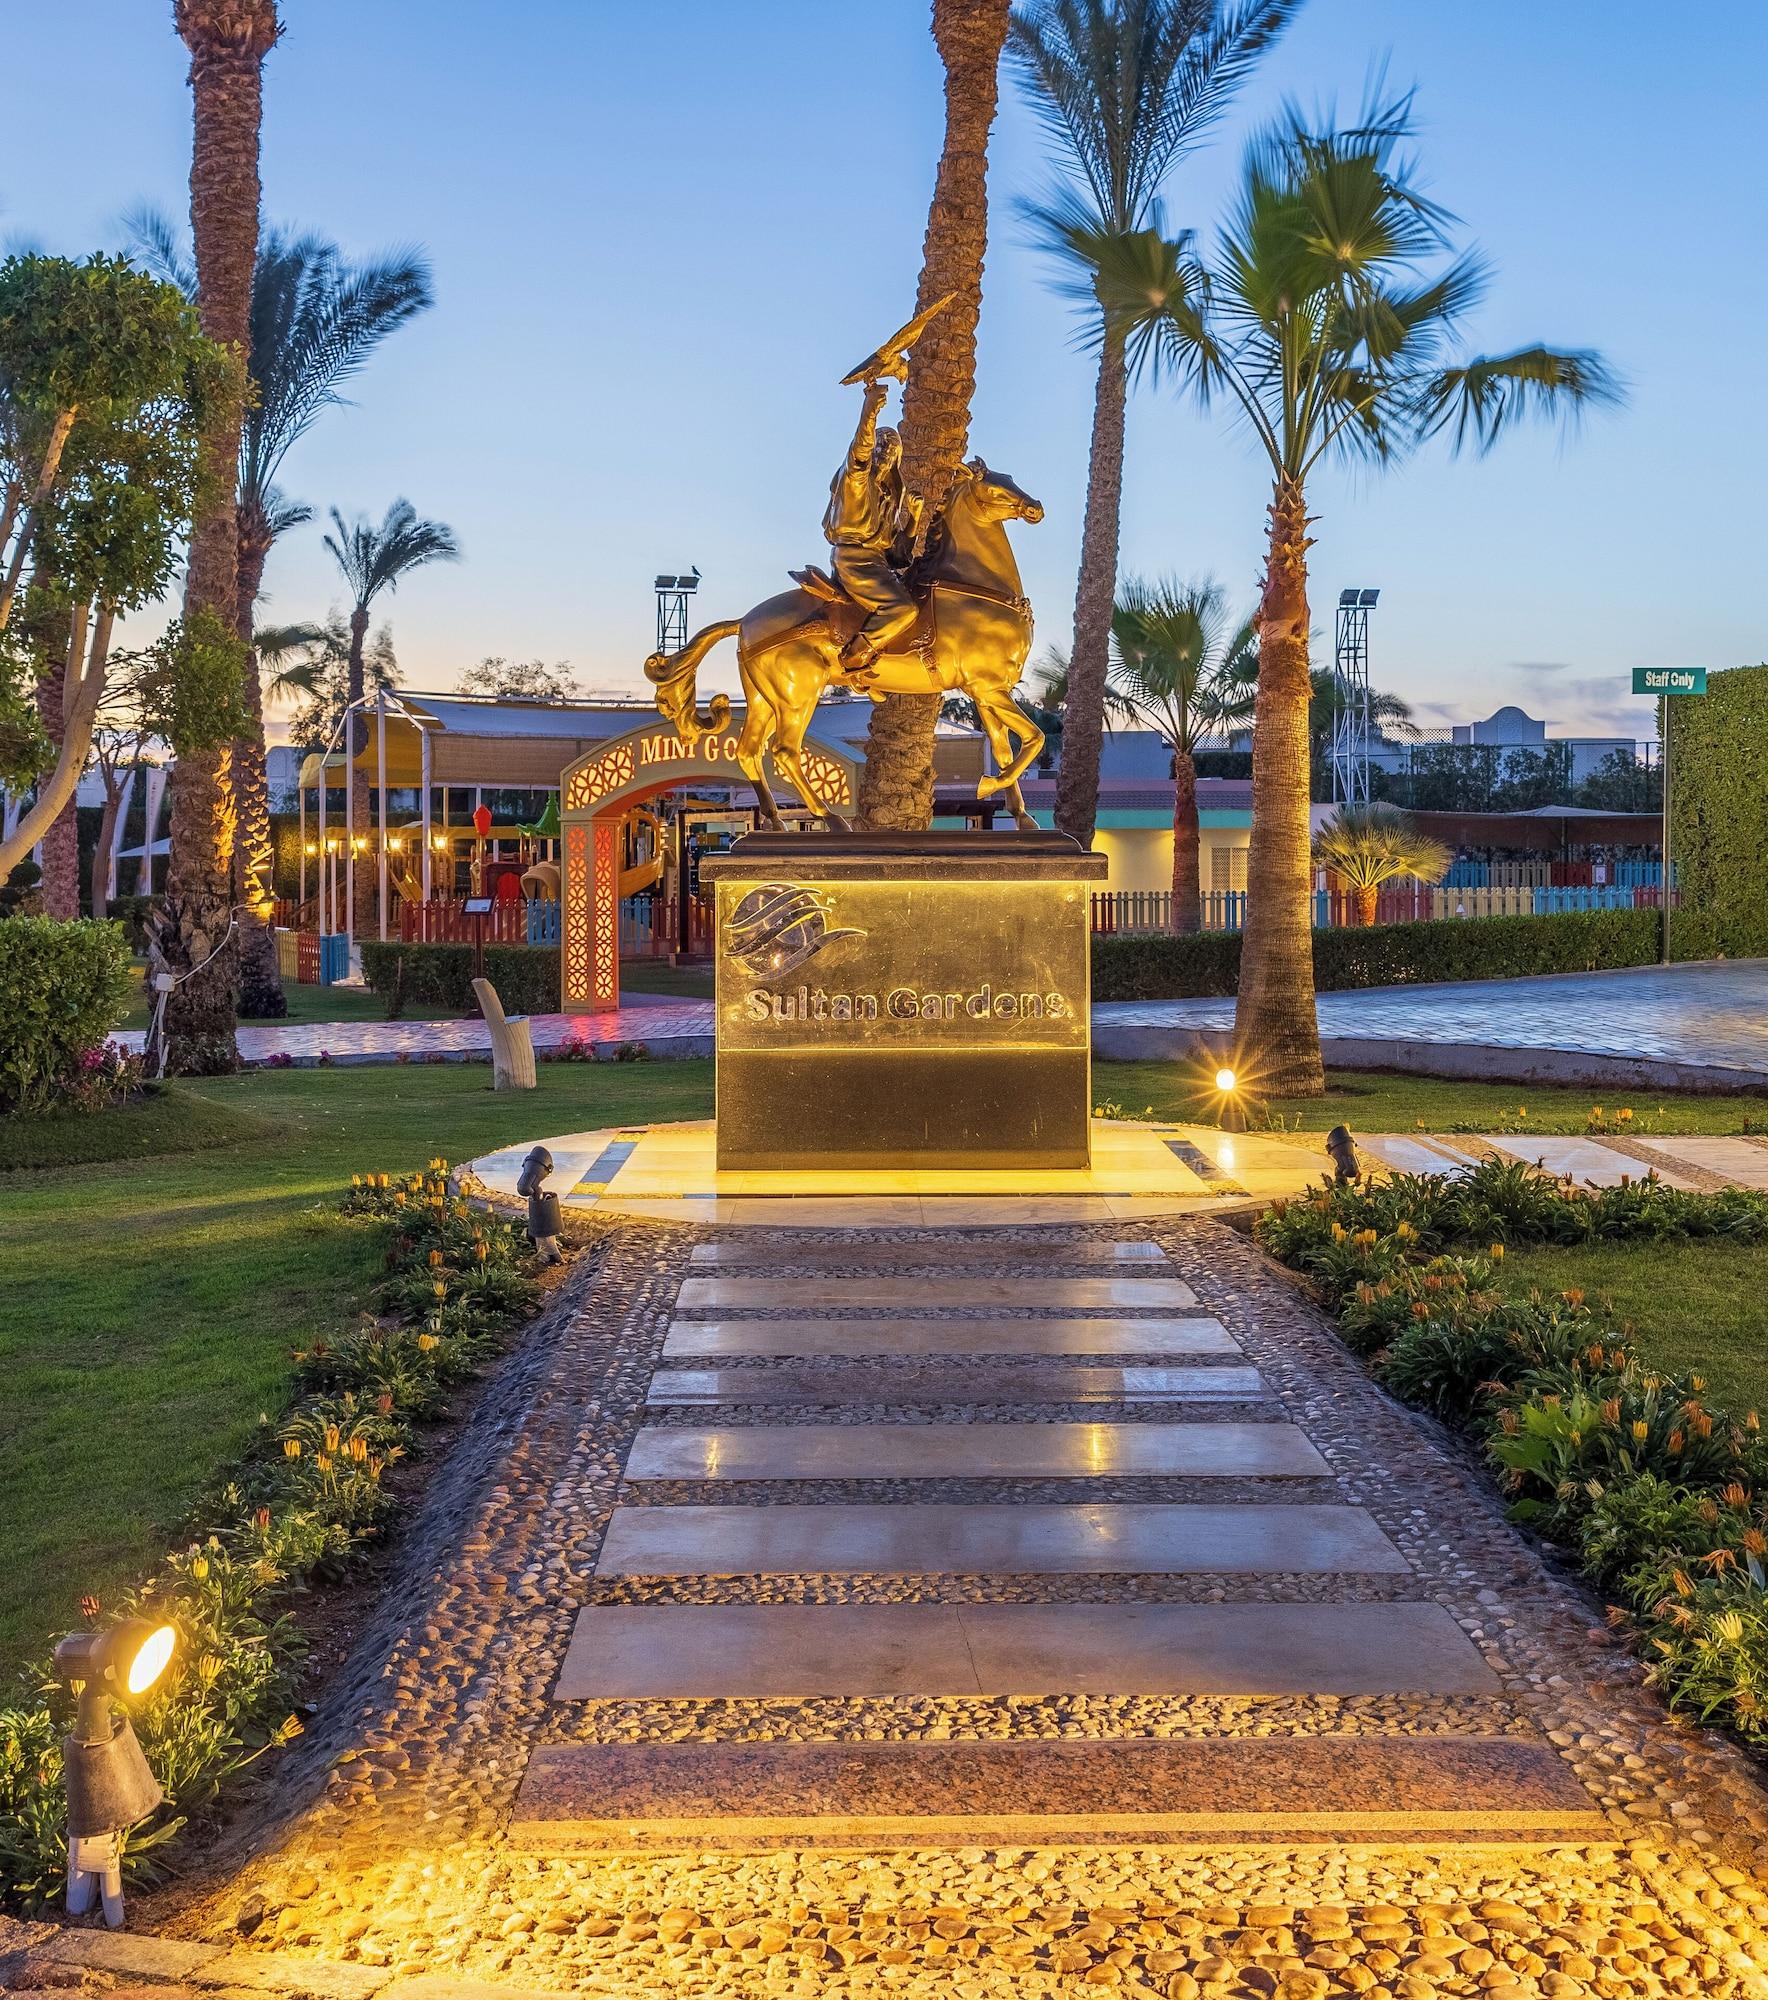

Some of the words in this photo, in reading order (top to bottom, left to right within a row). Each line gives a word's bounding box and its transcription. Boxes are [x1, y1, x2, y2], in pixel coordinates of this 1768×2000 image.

[1645, 671, 1669, 687] Staff
[1671, 672, 1695, 689] Only
[640, 735, 696, 765] MINI
[747, 985, 878, 1022] Sultan
[886, 983, 1065, 1021] Gardens
